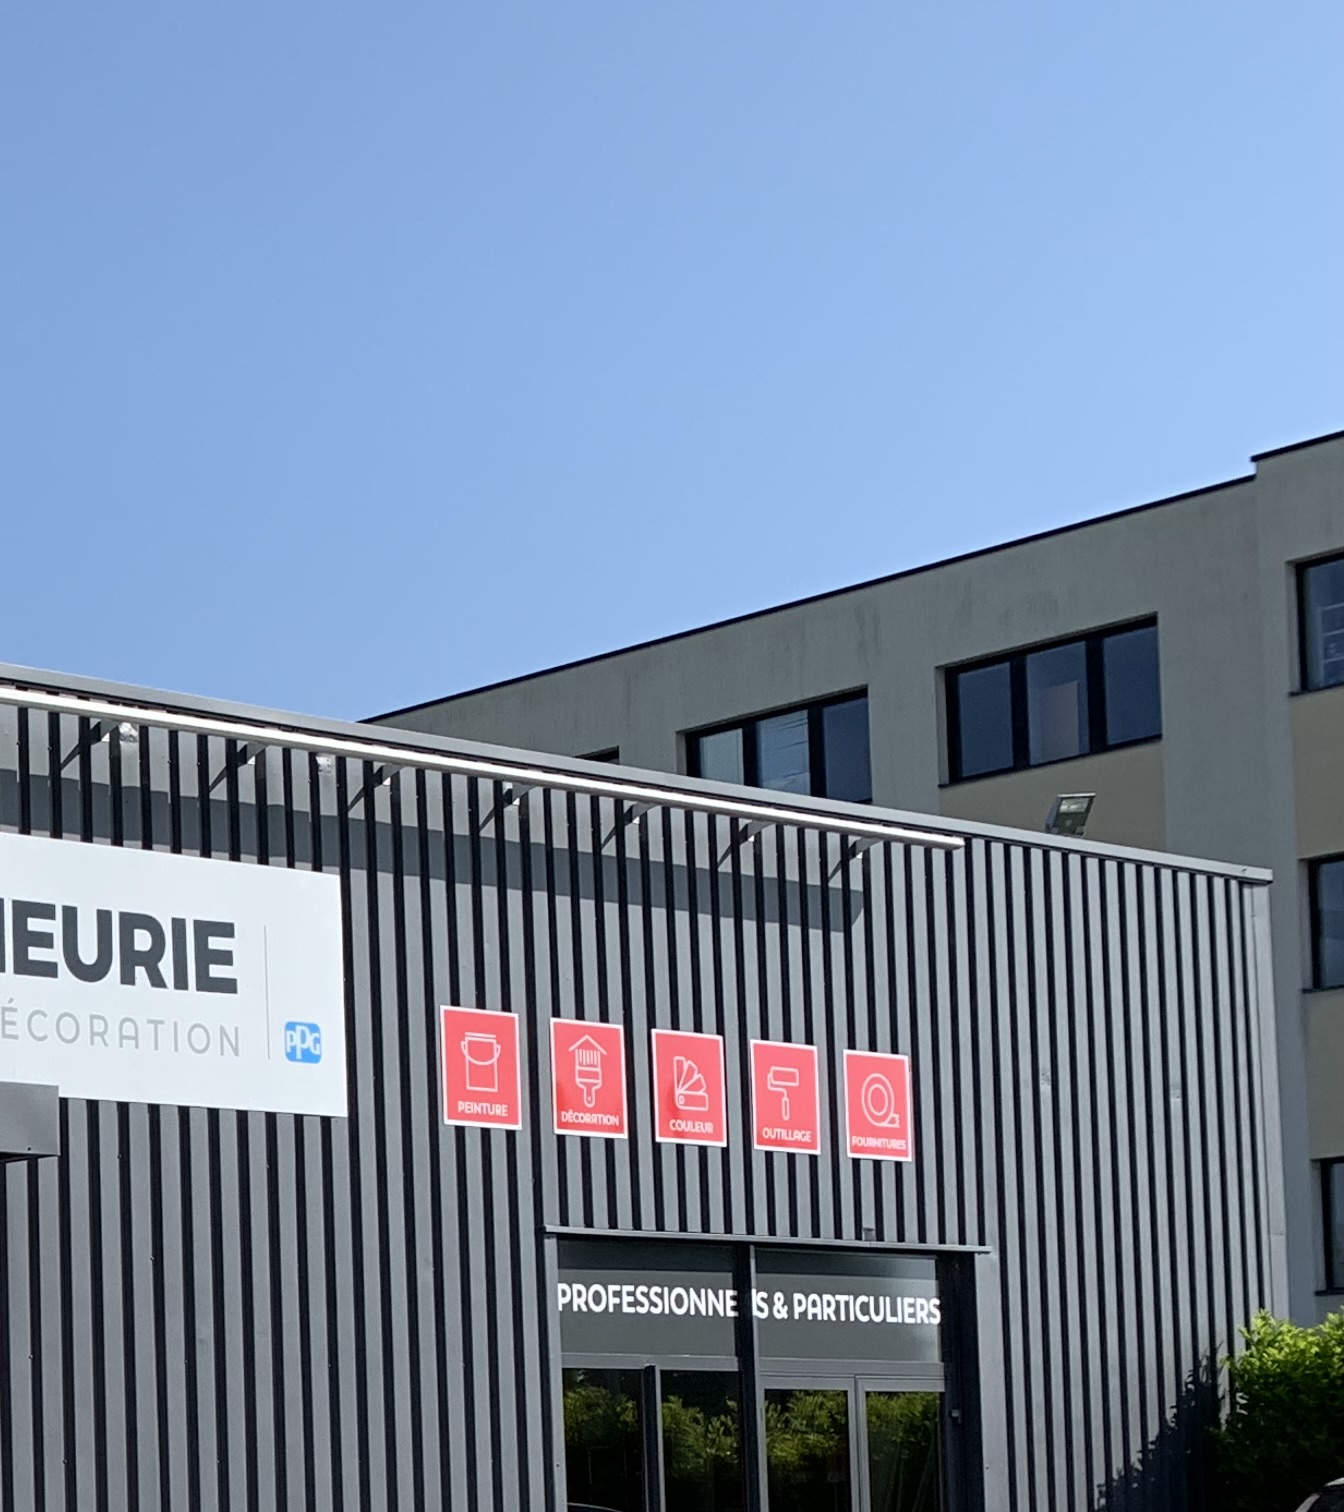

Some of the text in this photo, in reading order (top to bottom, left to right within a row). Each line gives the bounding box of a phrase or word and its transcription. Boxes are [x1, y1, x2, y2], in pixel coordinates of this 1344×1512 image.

[286, 1024, 321, 1060] PPG
[457, 1100, 509, 1118] PEINTURE
[561, 1108, 620, 1127] DÉCORATION
[669, 1118, 714, 1135] COULEUR
[762, 1126, 812, 1143] OUTILLAGE
[851, 1135, 907, 1151] FOURNITURES
[773, 1291, 788, 1320] &
[793, 1293, 942, 1325] PARTICULIERS
